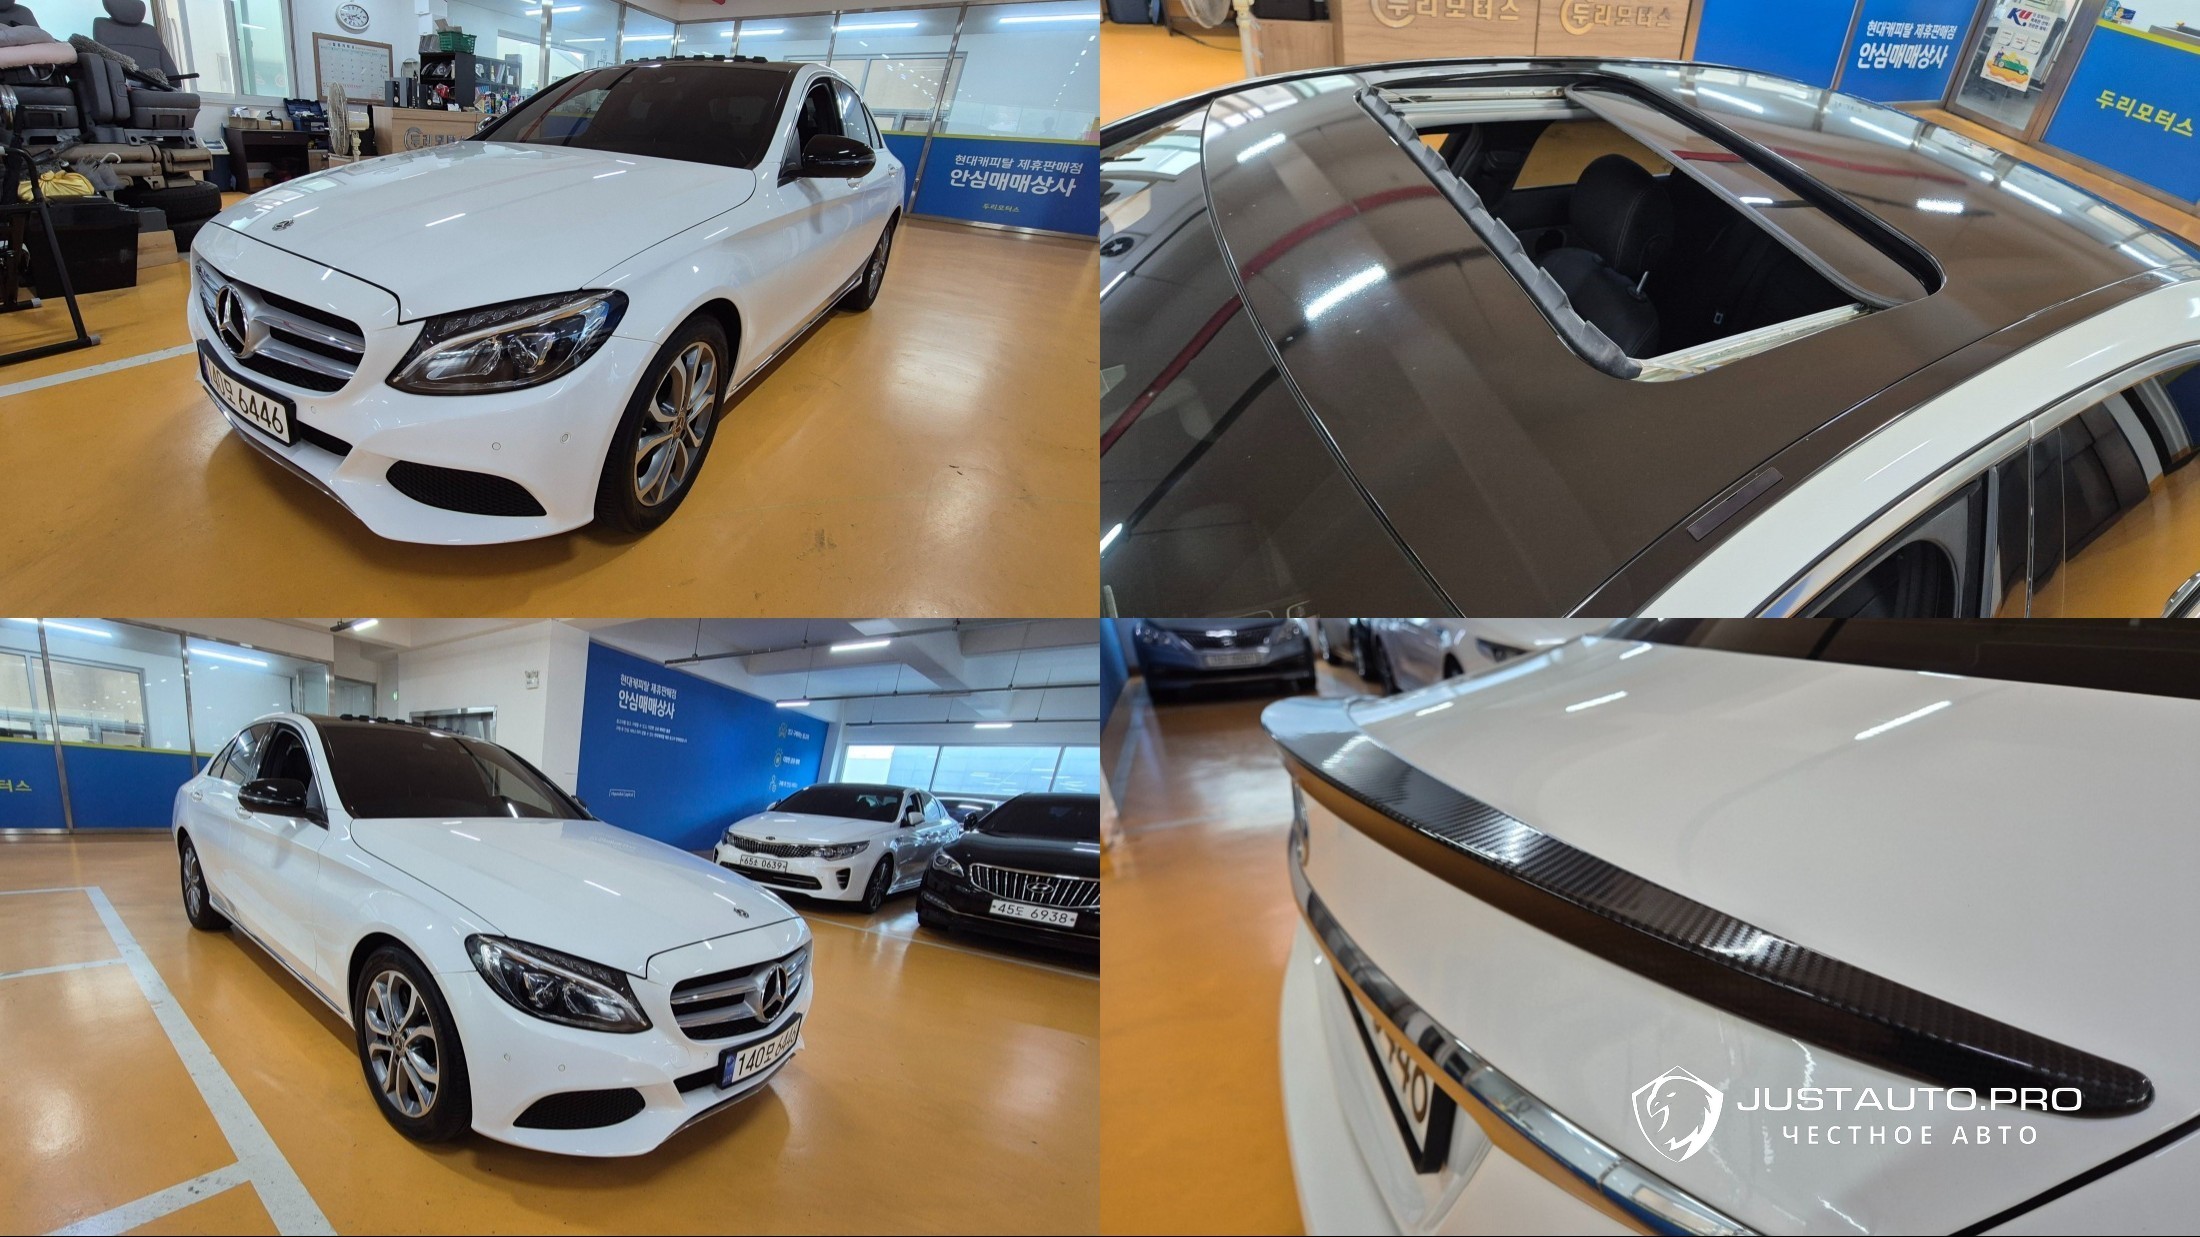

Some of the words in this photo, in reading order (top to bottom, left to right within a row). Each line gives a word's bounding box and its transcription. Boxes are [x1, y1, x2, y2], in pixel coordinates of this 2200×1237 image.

[1573, 3, 1671, 27] 두리모터스
[1867, 20, 1914, 38] 현대캐피탈
[1914, 24, 1957, 40] 제휴판매점
[1858, 42, 1949, 69] 안심매매상사
[2096, 89, 2193, 137] 두리모터스
[955, 154, 1014, 169] 현대캐피탈
[1017, 159, 1083, 174] 제휴판매점
[950, 169, 1077, 197] 안심매매상사
[239, 388, 283, 434] 6446
[618, 689, 675, 720] 안심매매상사
[761, 860, 782, 869] 0639
[1030, 909, 1068, 923] 6938
